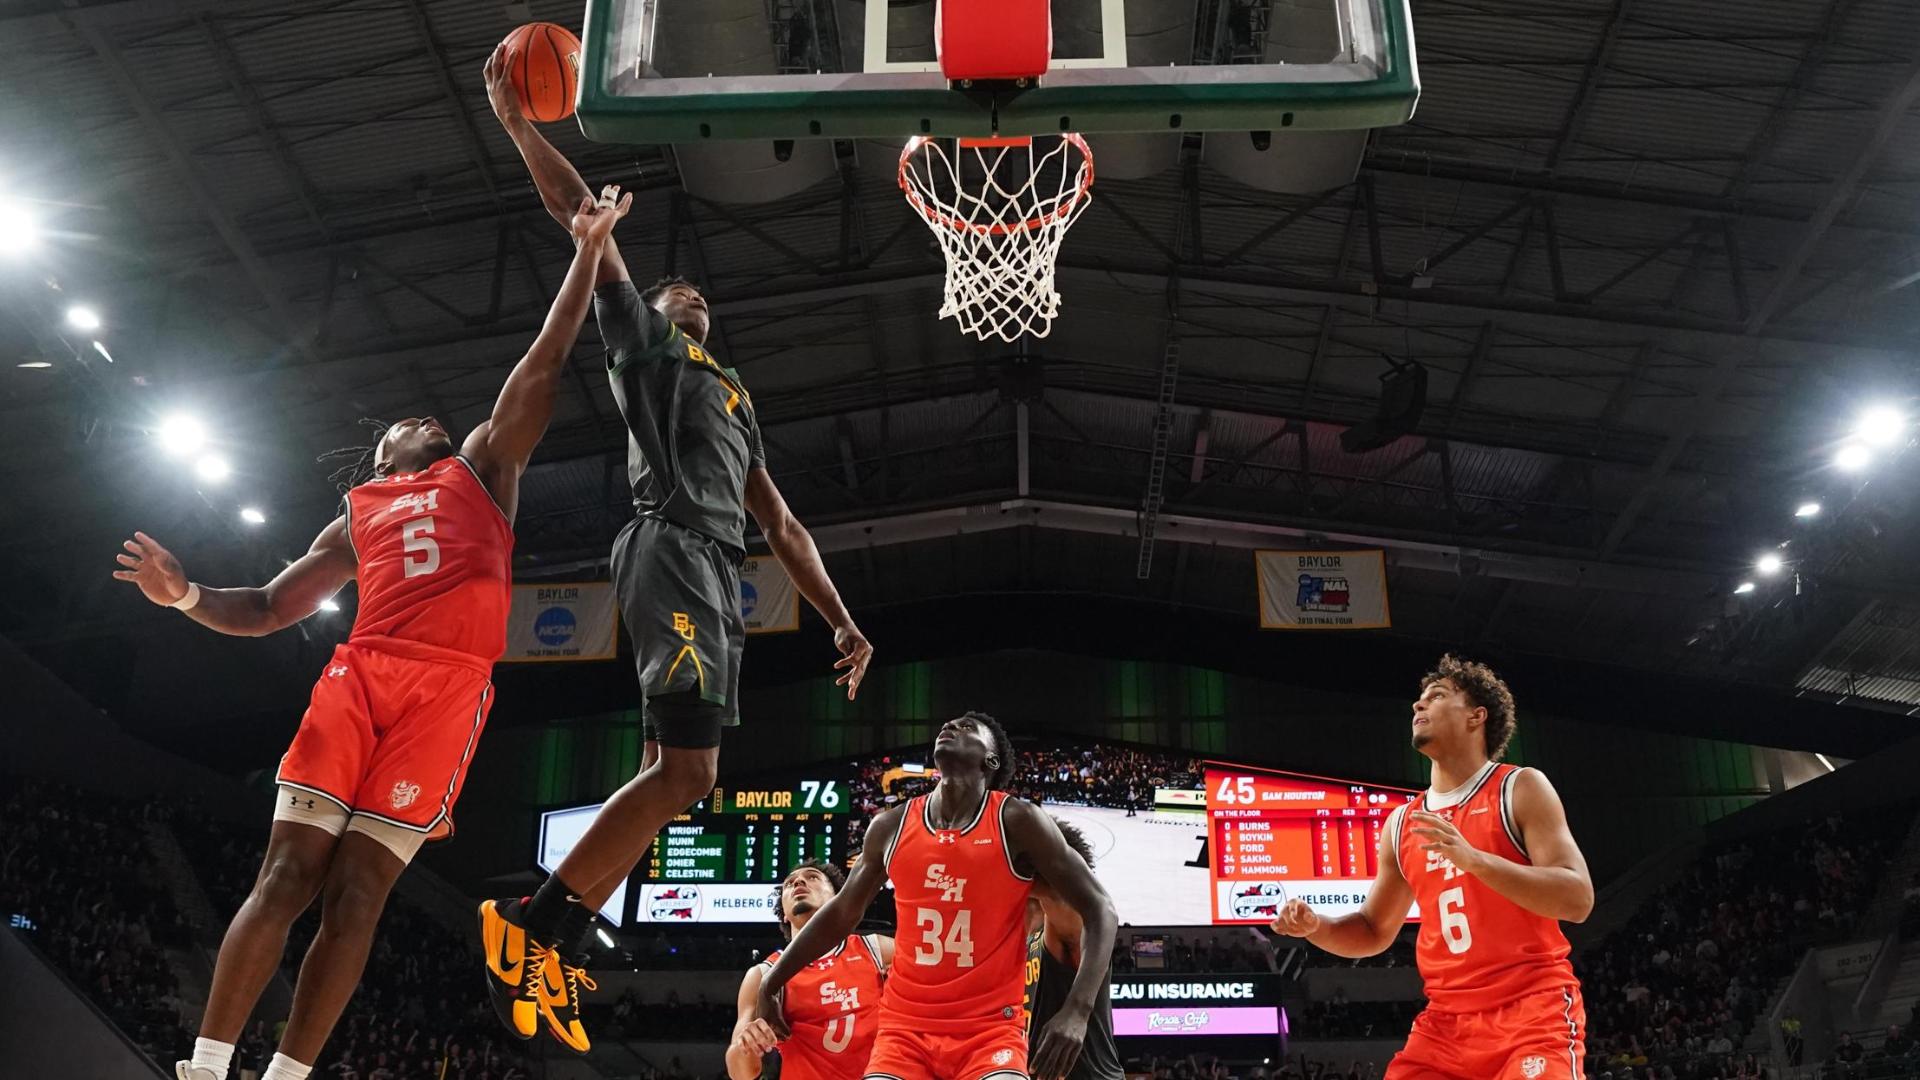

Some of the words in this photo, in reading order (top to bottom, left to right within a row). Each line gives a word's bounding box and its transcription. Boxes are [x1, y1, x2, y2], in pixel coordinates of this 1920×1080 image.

[402, 516, 441, 579] 5
[1298, 556, 1342, 568] BAYLOR
[537, 588, 579, 600] BAYLOR
[697, 800, 704, 809] 4
[736, 791, 792, 808] BAYLOR
[800, 780, 839, 809] 76
[1216, 777, 1256, 805] 45
[1262, 791, 1283, 801] SAM
[1284, 791, 1326, 800] HOUSTON
[1354, 795, 1361, 804] 7
[668, 826, 704, 835] WRIGHT
[747, 825, 754, 834] 7
[773, 825, 780, 834] 2
[799, 825, 806, 834] 4
[825, 825, 832, 834] 0
[1224, 822, 1231, 830] 0
[1238, 822, 1270, 831] BURNS
[1321, 821, 1327, 829] 2
[1347, 821, 1352, 829] 1
[1373, 821, 1379, 829] 3
[653, 837, 660, 846] 2
[667, 837, 695, 846] NUNN
[746, 837, 756, 845] 17
[773, 837, 780, 846] 2
[799, 837, 805, 845] 3
[825, 837, 832, 845] 0
[1239, 833, 1273, 842] BOYKIN
[1322, 832, 1328, 841] 2
[1348, 832, 1353, 840] 1
[1374, 832, 1380, 840] 3
[653, 848, 660, 856] 7
[667, 848, 722, 857] EDGECOMBE
[747, 848, 753, 856] 9
[772, 848, 779, 856] 6
[824, 848, 831, 856] 3
[1240, 844, 1265, 852] FORD
[1349, 843, 1354, 851] 1
[650, 859, 660, 868] 15
[666, 859, 695, 867] OMIER
[1224, 855, 1235, 863] 34
[1240, 855, 1271, 863] SAKHO
[648, 870, 660, 878] 32
[665, 870, 715, 878] CELESTINE
[745, 870, 752, 879] 7
[771, 870, 778, 878] 3
[1241, 866, 1288, 875] HAMMONS
[713, 898, 763, 908] HELBERG
[1438, 886, 1472, 955] 6
[915, 907, 975, 967] 34
[1148, 983, 1254, 999] INSURANCE
